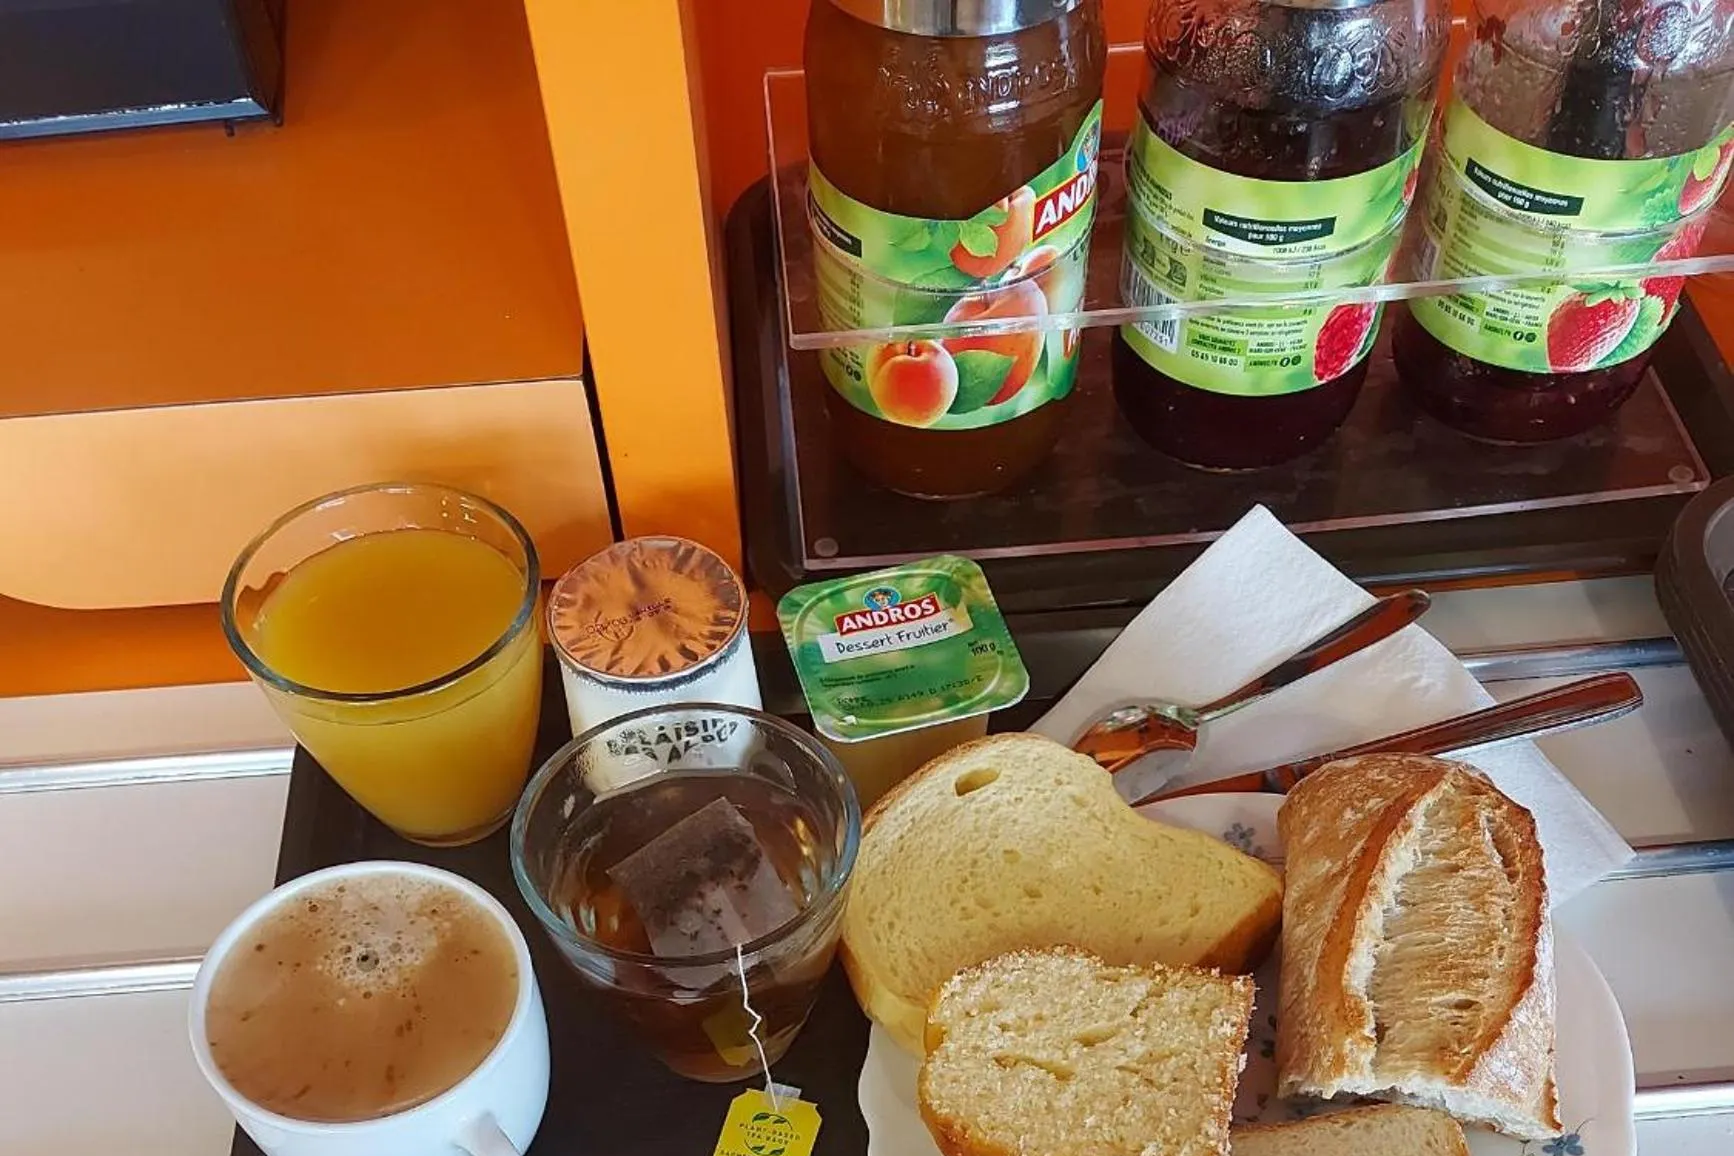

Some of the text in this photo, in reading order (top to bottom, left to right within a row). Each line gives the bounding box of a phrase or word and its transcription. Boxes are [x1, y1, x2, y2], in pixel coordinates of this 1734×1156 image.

[842, 598, 936, 633] ANDROS
[835, 622, 949, 654] Dessert Fruitier
